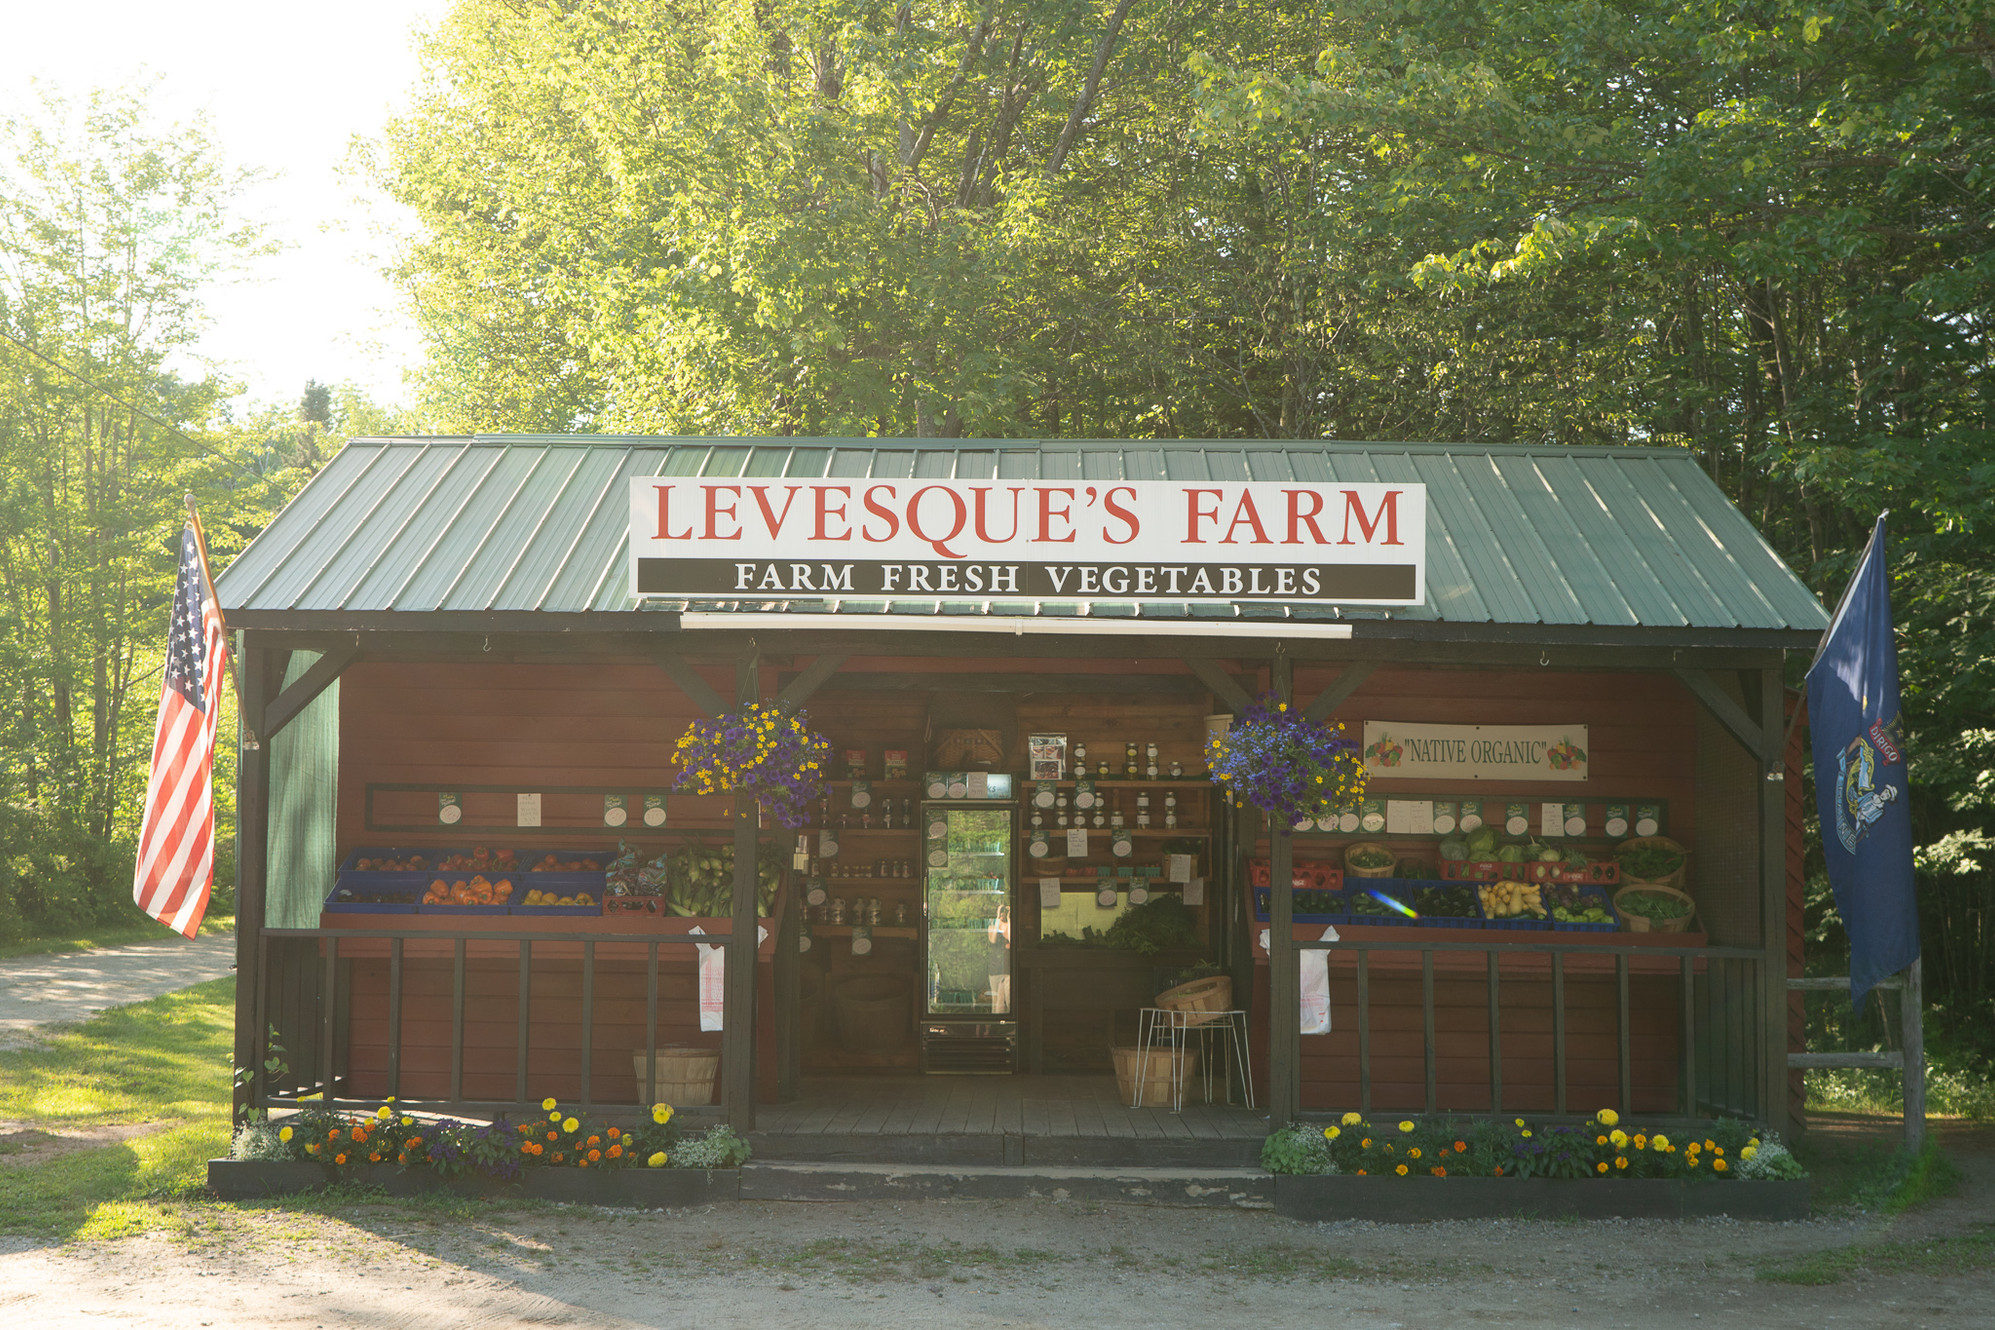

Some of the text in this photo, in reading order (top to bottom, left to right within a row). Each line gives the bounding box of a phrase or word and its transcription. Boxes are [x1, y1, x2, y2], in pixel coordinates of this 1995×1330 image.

[651, 485, 1405, 559] LEVESQUE'S FARM
[734, 563, 1322, 596] FARM FRESH VEGETABLES
[1404, 738, 1547, 764] "NATIVE ORGANIC"
[1870, 726, 1899, 762] DIRIGO
